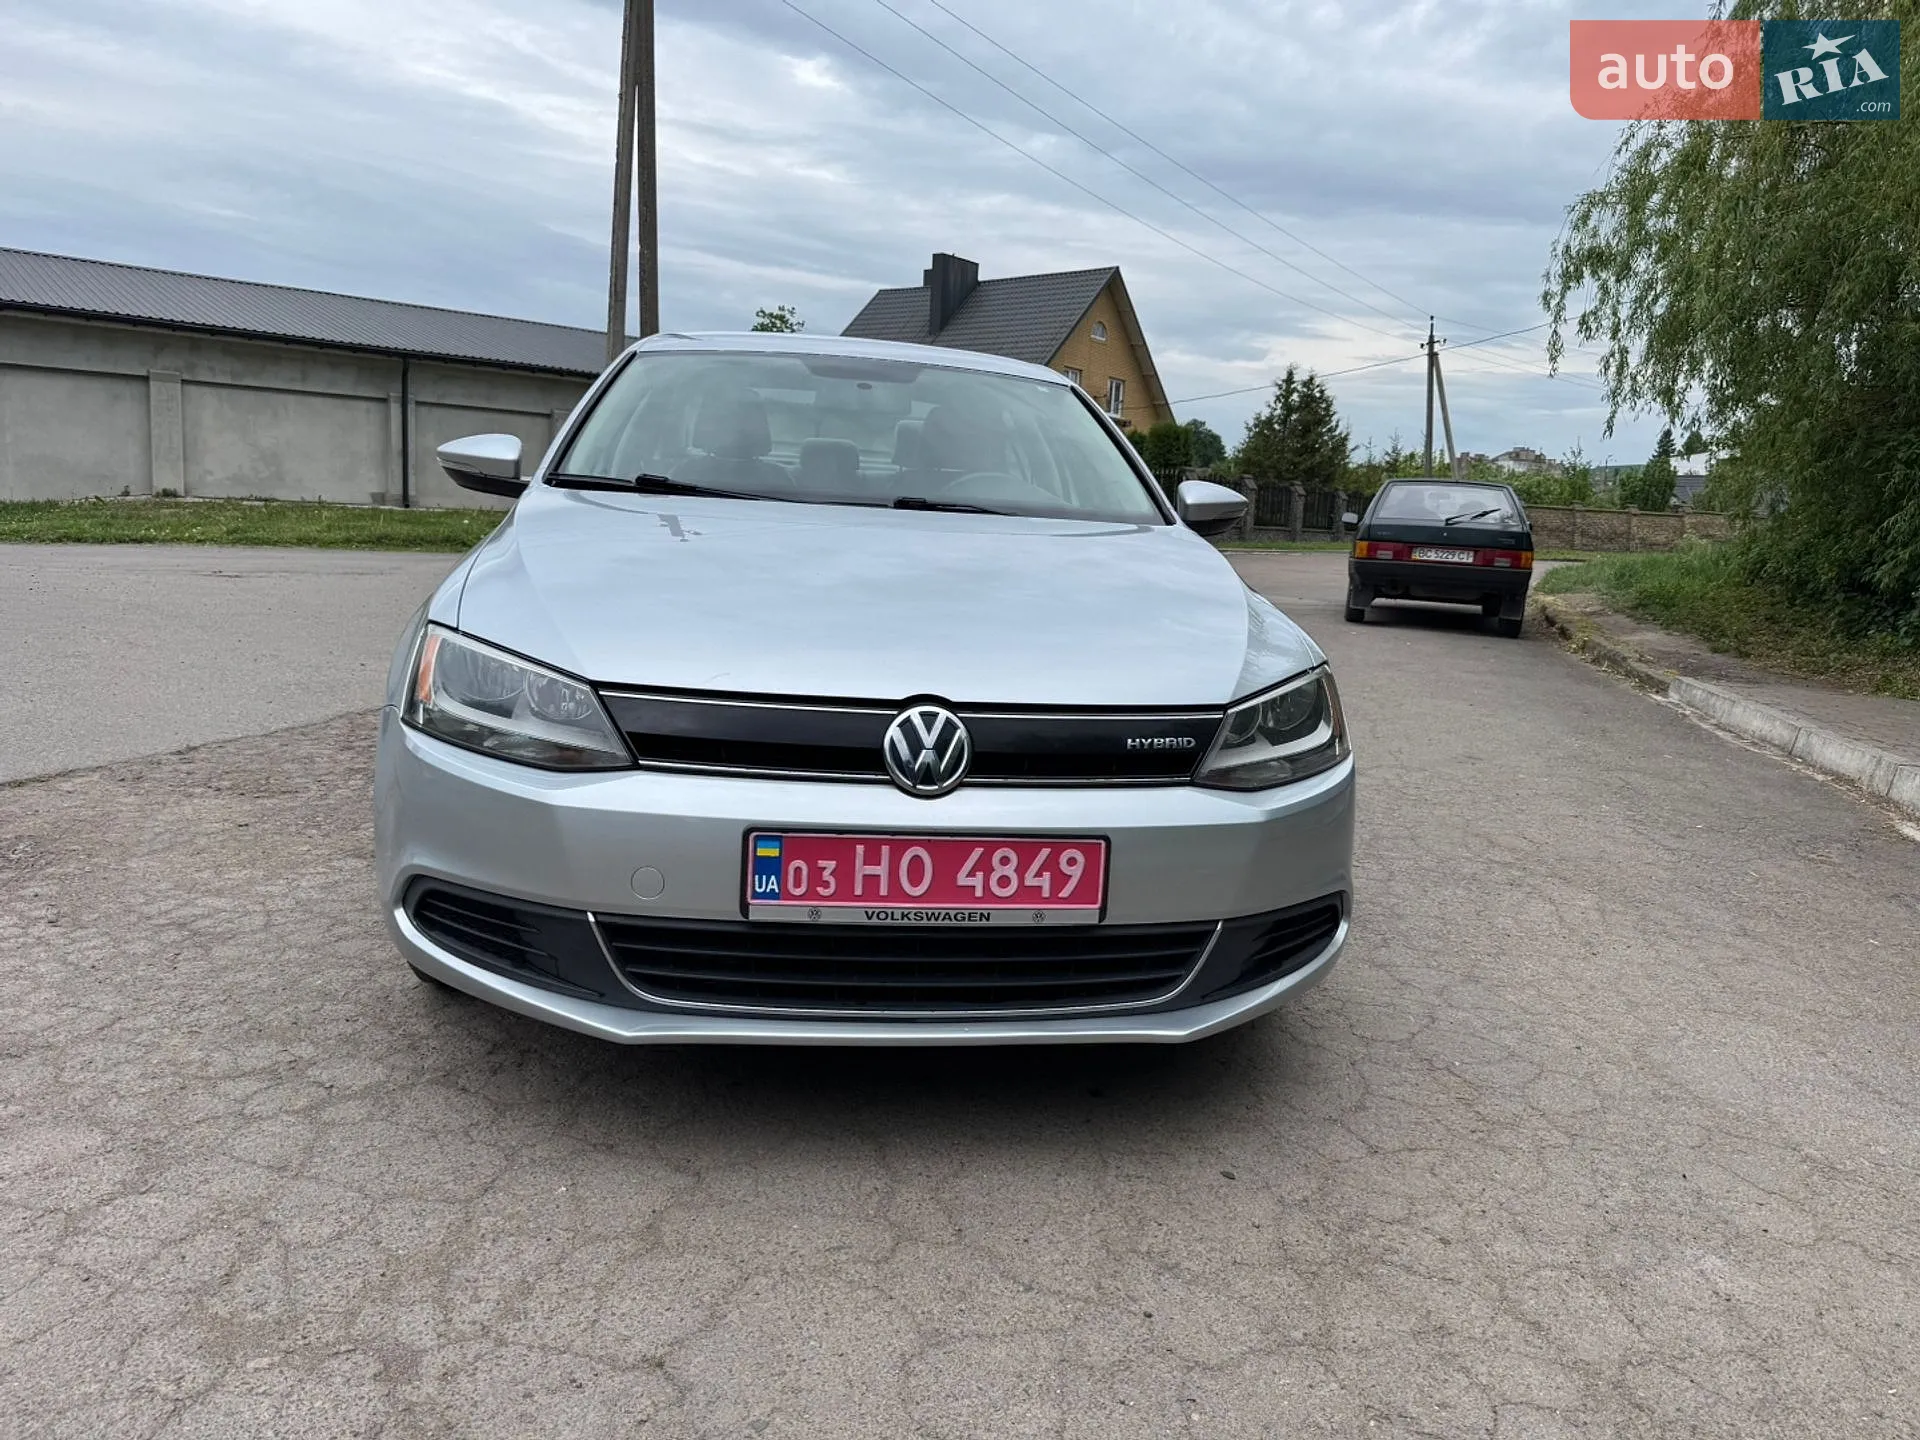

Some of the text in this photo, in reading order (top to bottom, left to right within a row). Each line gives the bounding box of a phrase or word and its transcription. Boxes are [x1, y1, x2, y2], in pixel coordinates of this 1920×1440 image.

[1127, 737, 1196, 749] HYBRID
[786, 844, 1086, 899] 03 HO 4849
[754, 874, 779, 894] UA
[864, 909, 991, 923] VOLKSWAGEN
